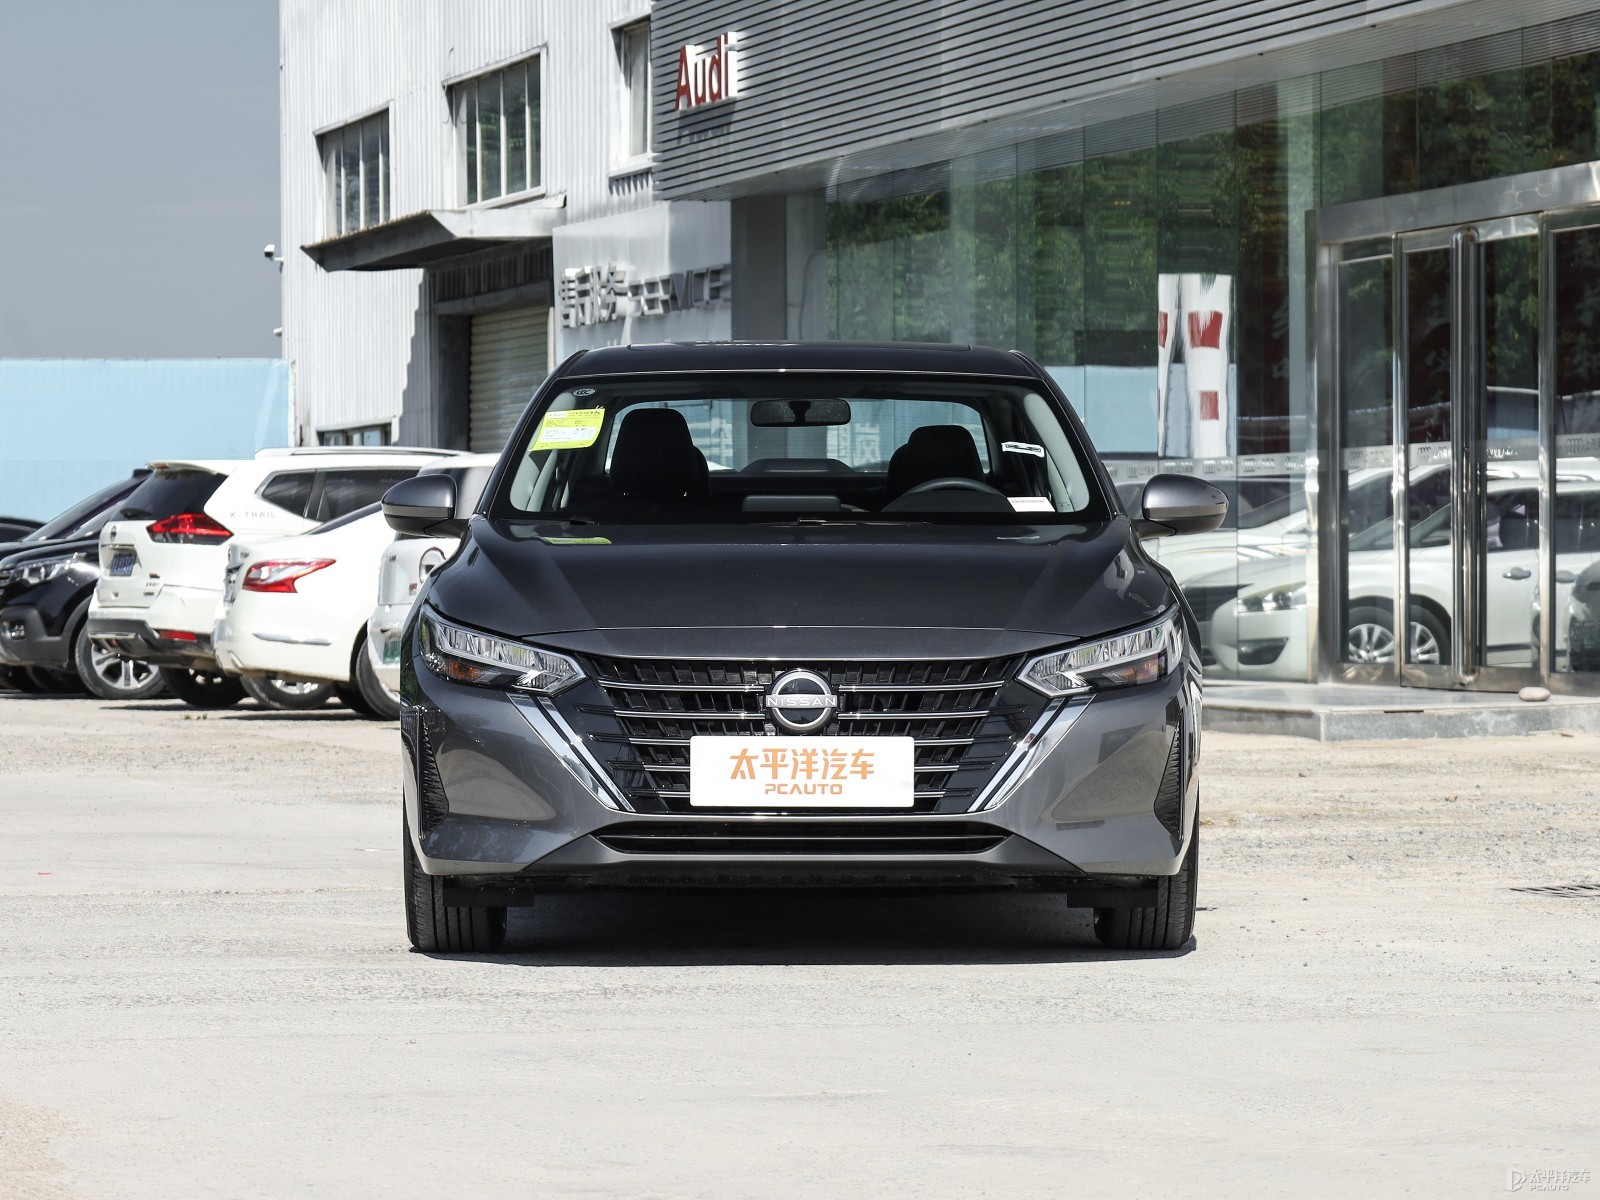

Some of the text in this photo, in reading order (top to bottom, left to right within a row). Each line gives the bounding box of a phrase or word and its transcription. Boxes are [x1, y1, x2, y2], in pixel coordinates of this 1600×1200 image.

[675, 31, 735, 111] Audi
[767, 697, 837, 706] NISSAN
[729, 748, 875, 780] 太平洋汽车
[764, 783, 843, 795] PCAUTO
